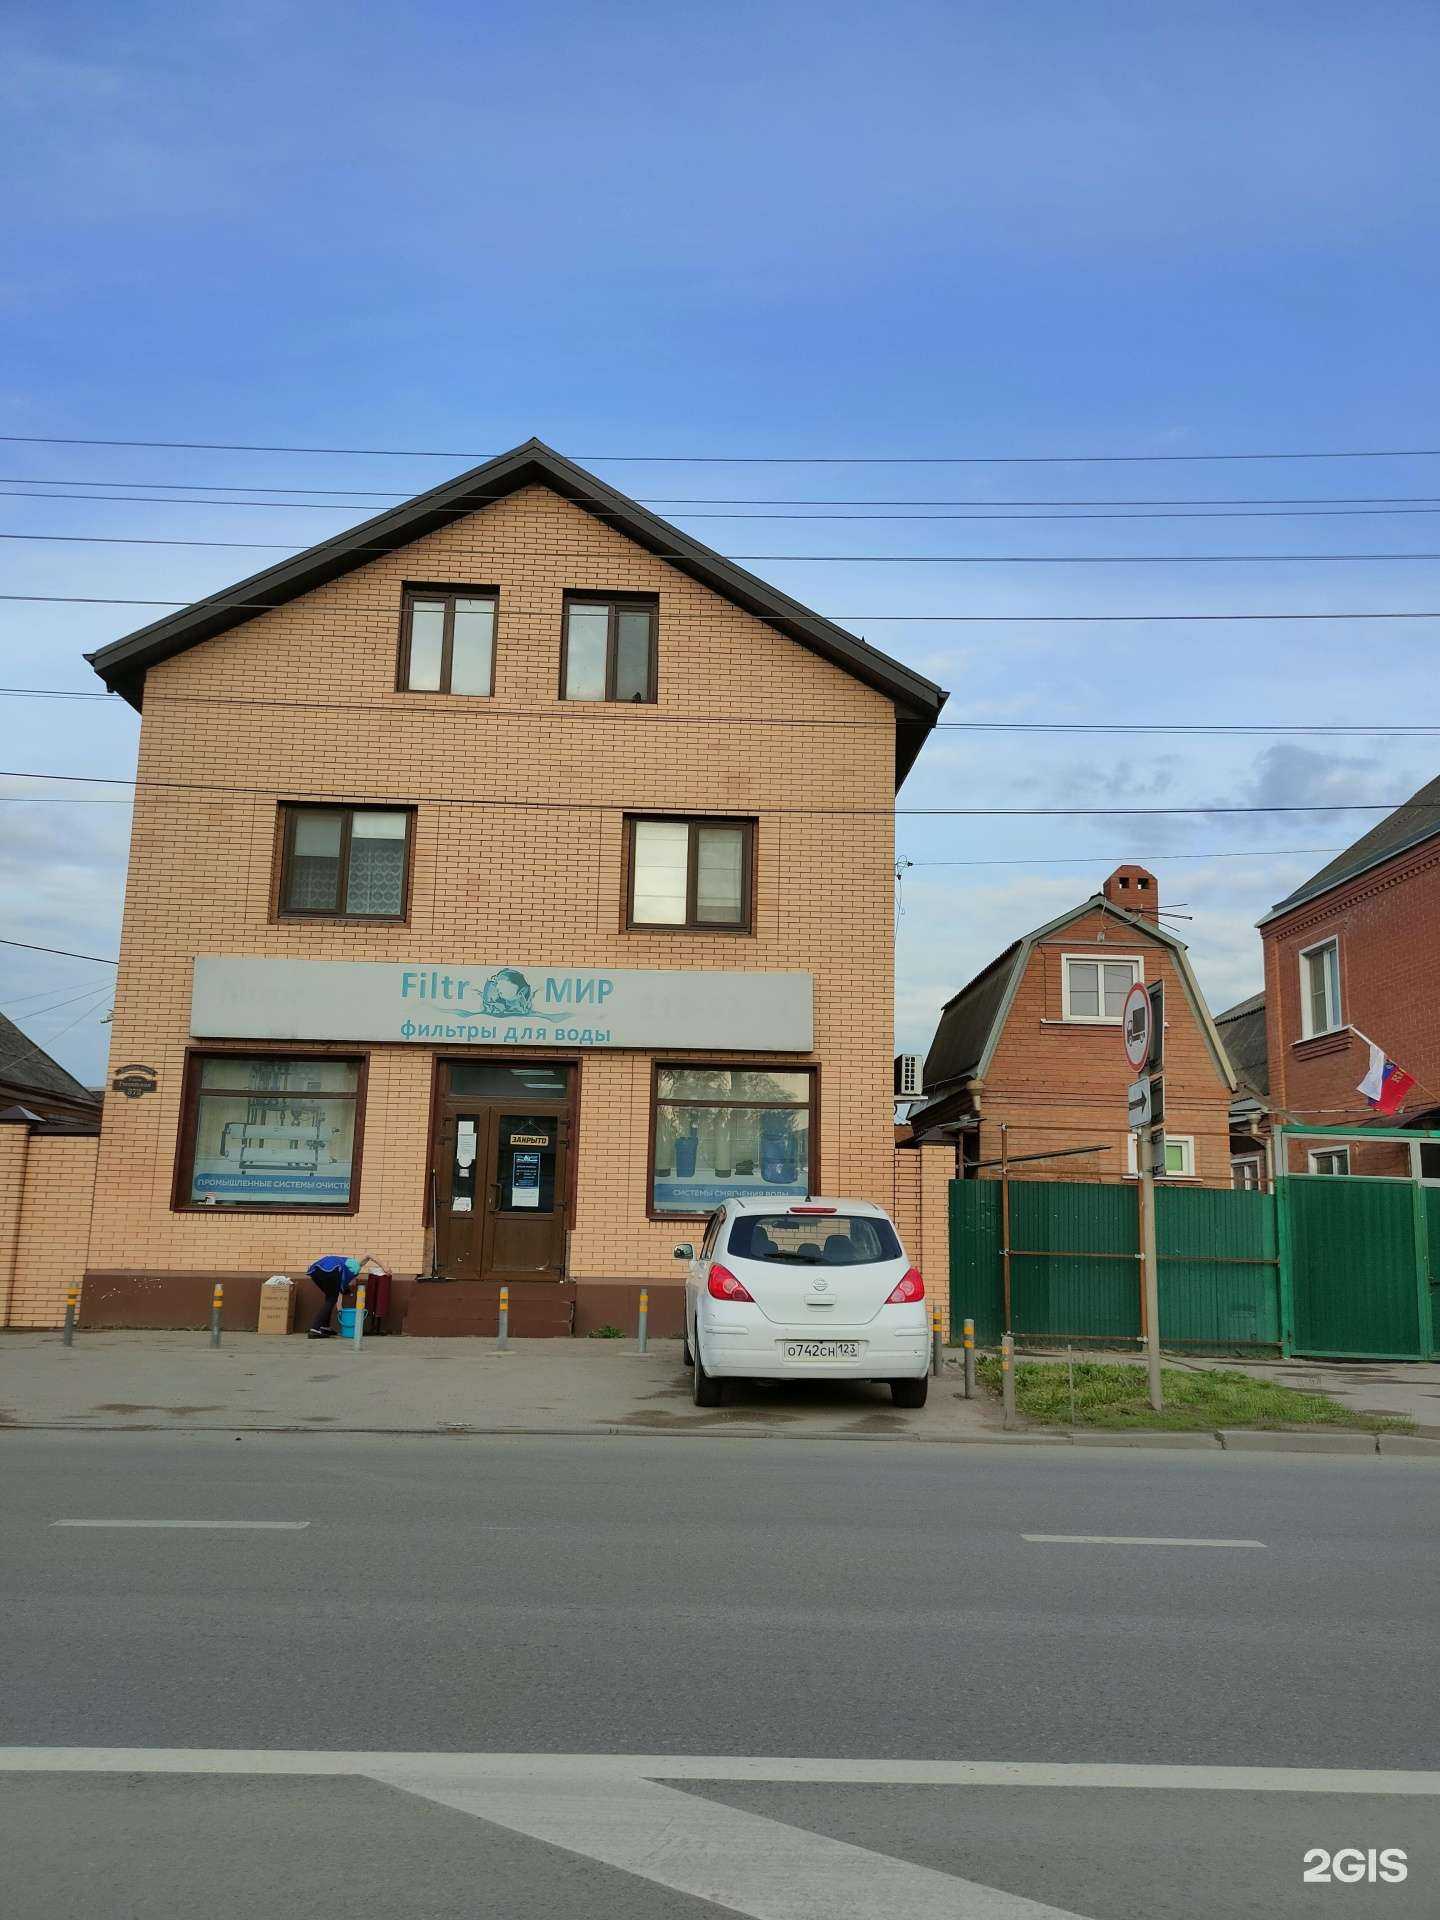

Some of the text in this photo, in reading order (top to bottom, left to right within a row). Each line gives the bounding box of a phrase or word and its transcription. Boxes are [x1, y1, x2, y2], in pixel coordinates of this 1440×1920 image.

[402, 971, 615, 1004] Filtr МИР
[400, 1019, 611, 1045] фильтры для воды
[511, 1135, 547, 1145] ЗАКРЫТО
[198, 1178, 272, 1188] ПРОМЫШЛЕННЫЕ
[273, 1180, 315, 1189] СИСТЕМЫ
[672, 1189, 713, 1198] СИСТЕМЫ
[838, 1343, 857, 1354] 123
